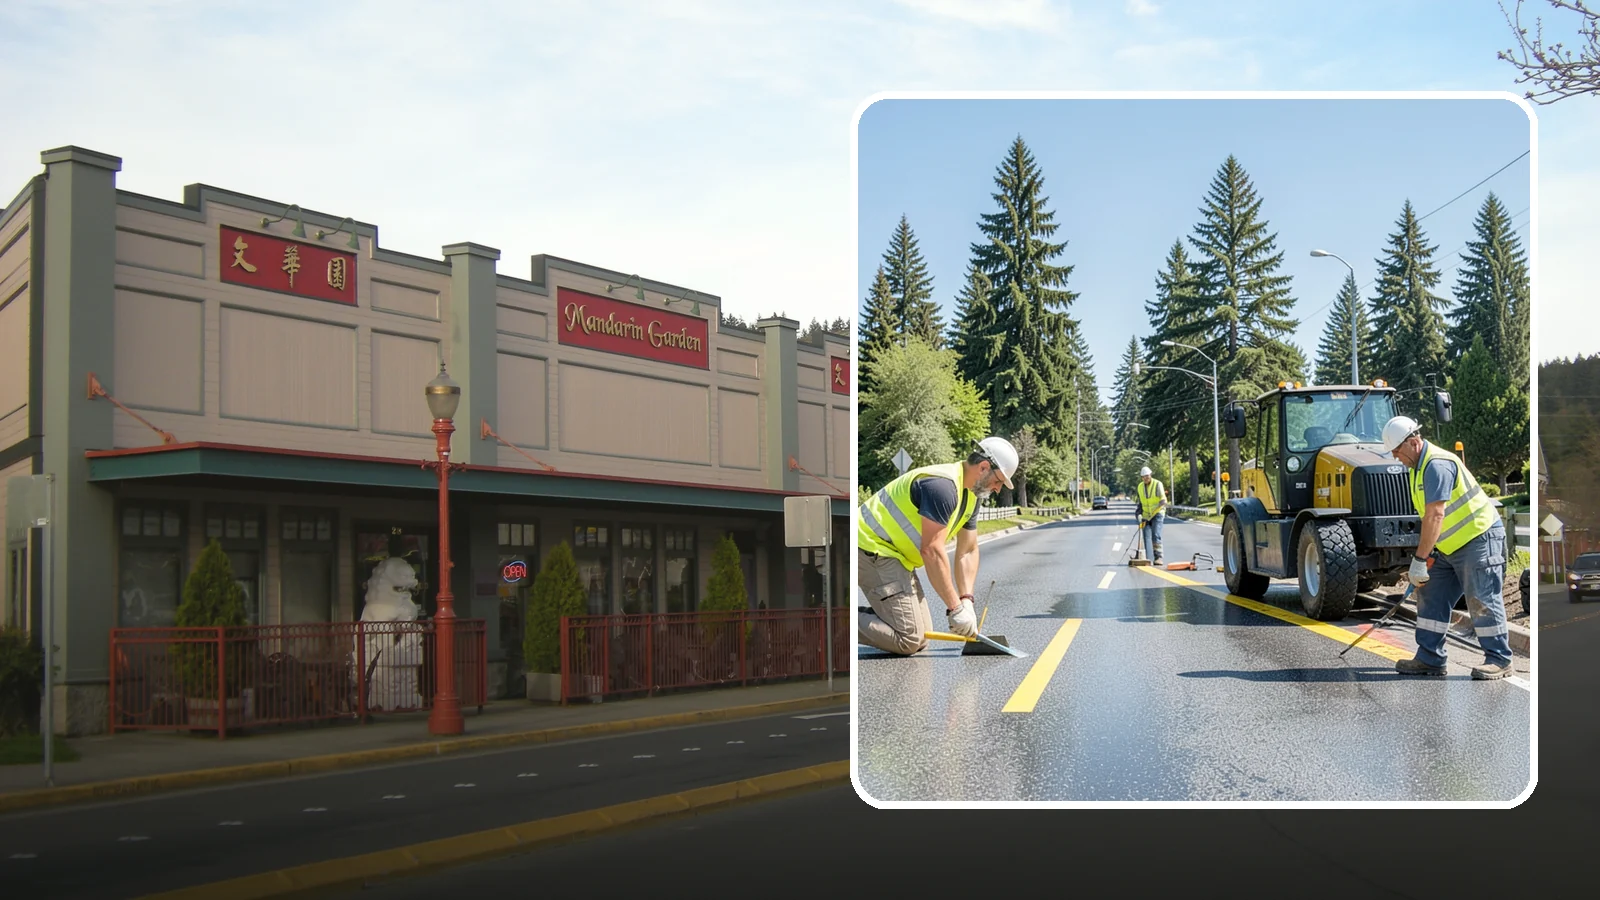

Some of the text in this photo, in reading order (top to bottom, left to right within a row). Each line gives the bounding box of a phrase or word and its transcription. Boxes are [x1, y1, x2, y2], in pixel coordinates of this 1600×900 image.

[230, 235, 346, 291] 文華園
[564, 302, 702, 352] Mandarin Garden
[503, 565, 527, 578] OPEN
